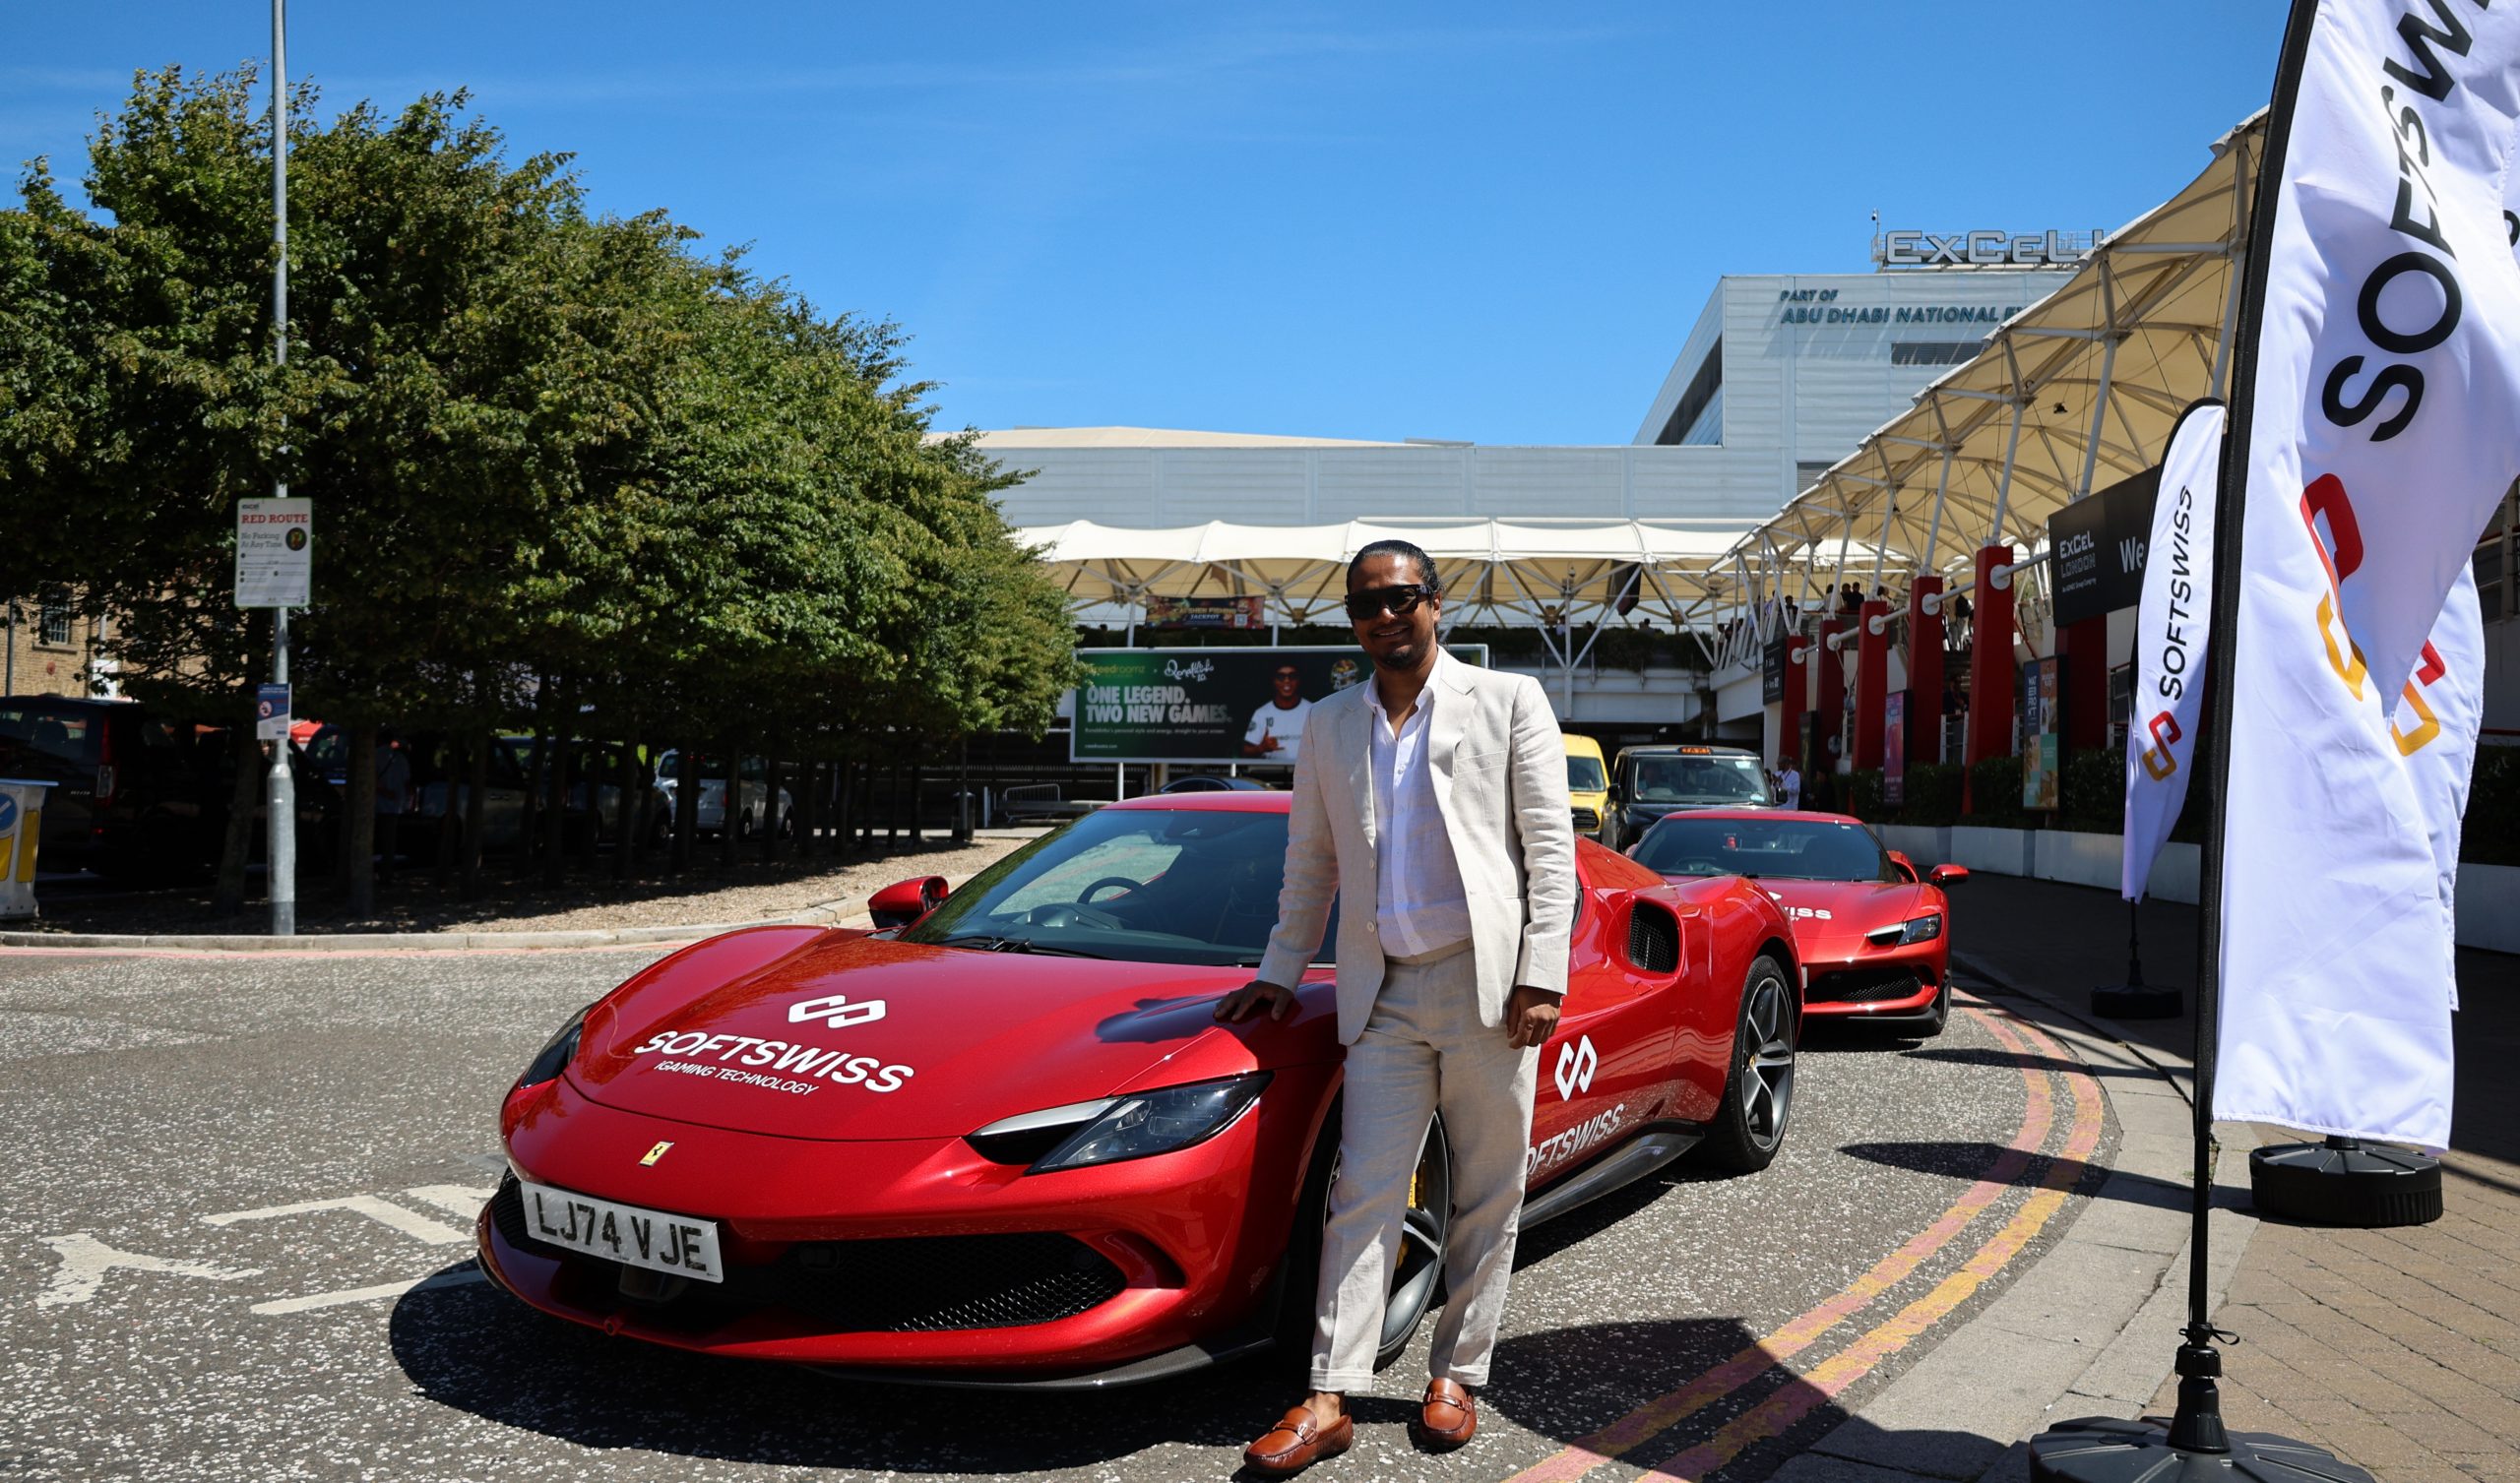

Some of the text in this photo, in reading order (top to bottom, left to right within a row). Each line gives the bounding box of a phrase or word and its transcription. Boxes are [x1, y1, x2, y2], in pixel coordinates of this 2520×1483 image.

[2321, 0, 2488, 442] SOFTSW
[1780, 289, 1839, 301] PART OF
[1780, 307, 1824, 324] ABU
[1827, 307, 1891, 324] DHABI
[1896, 306, 1999, 323] NATIONAL
[241, 514, 308, 524] RED ROUTE
[2060, 552, 2096, 579] LONDON
[2119, 535, 2145, 574] We
[2159, 484, 2192, 701] SOFTSWISS
[1086, 686, 1191, 705] ONE LEGEND.
[1086, 705, 1233, 723] TWO NEW GAMES.
[1266, 716, 1274, 727] 10
[634, 1030, 914, 1092] SOFTSWISS
[654, 1059, 819, 1096] iGAMING TECHNOLOGY
[536, 1193, 708, 1271] LJ74 VJE
